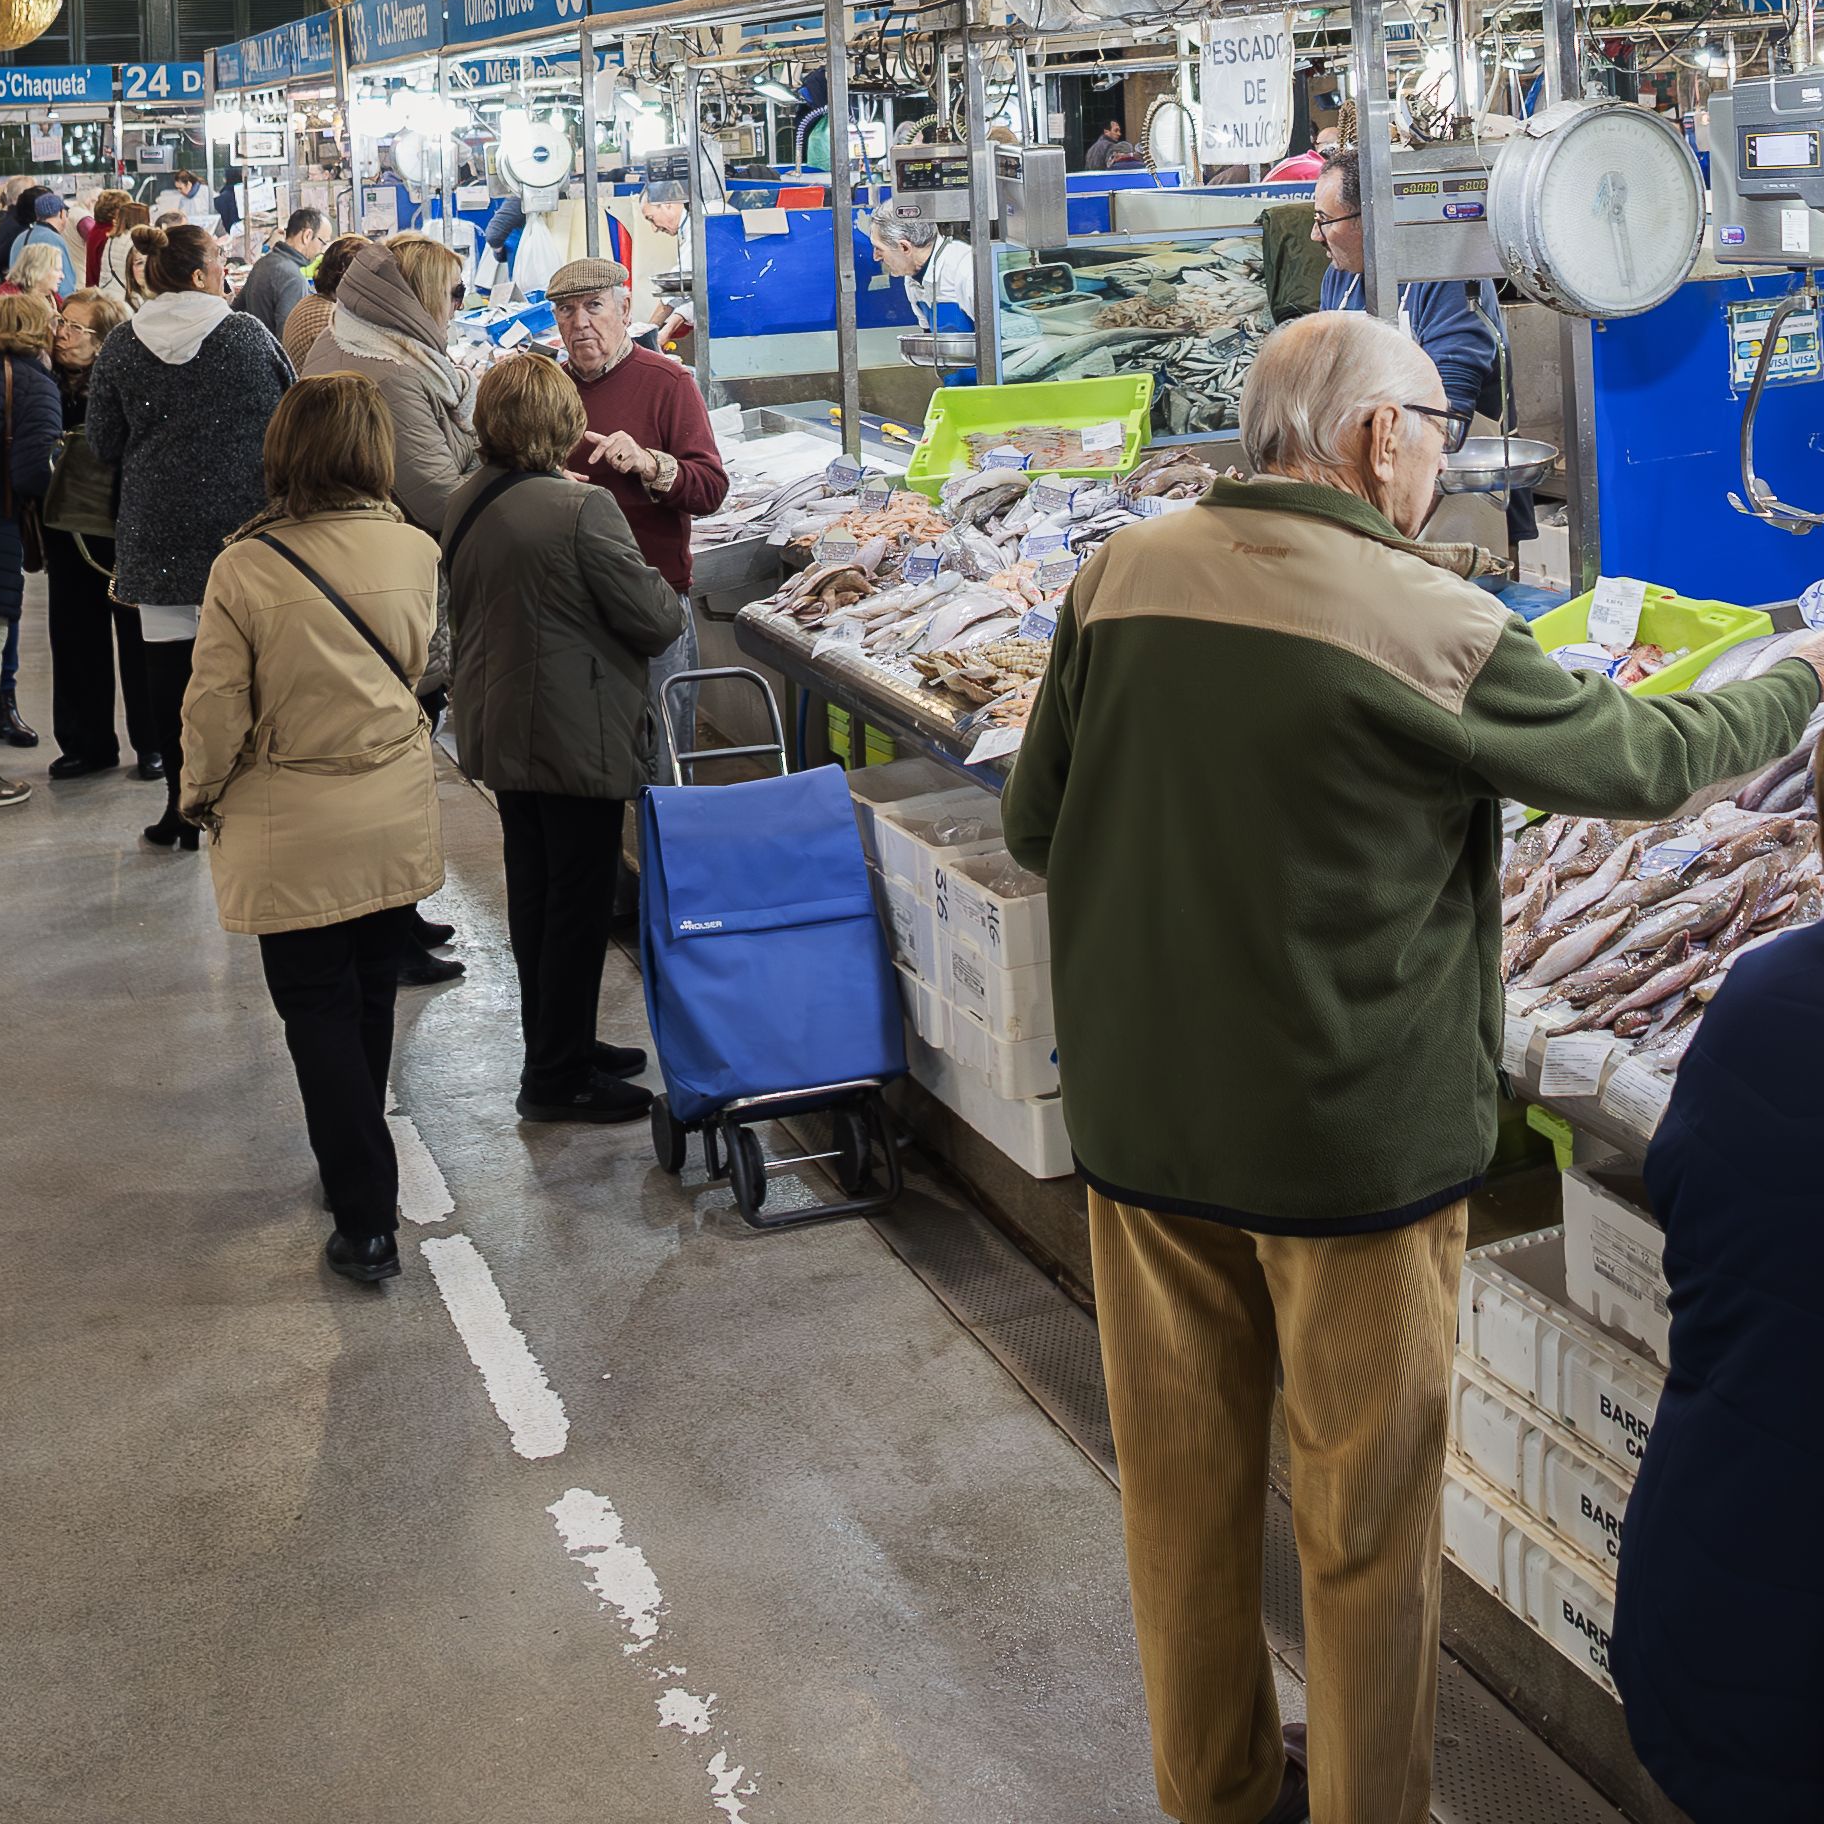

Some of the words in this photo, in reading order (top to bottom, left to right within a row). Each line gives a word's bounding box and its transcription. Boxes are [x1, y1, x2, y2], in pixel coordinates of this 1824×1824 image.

[376, 0, 428, 47] J.C.Herrera
[125, 65, 170, 99] 24
[1243, 78, 1267, 106] DE
[1795, 354, 1815, 365] VISA
[688, 920, 723, 931] ROLSER
[1600, 1393, 1650, 1444] BARR
[1580, 1493, 1623, 1542] BAR
[1562, 1599, 1610, 1651] BARR
